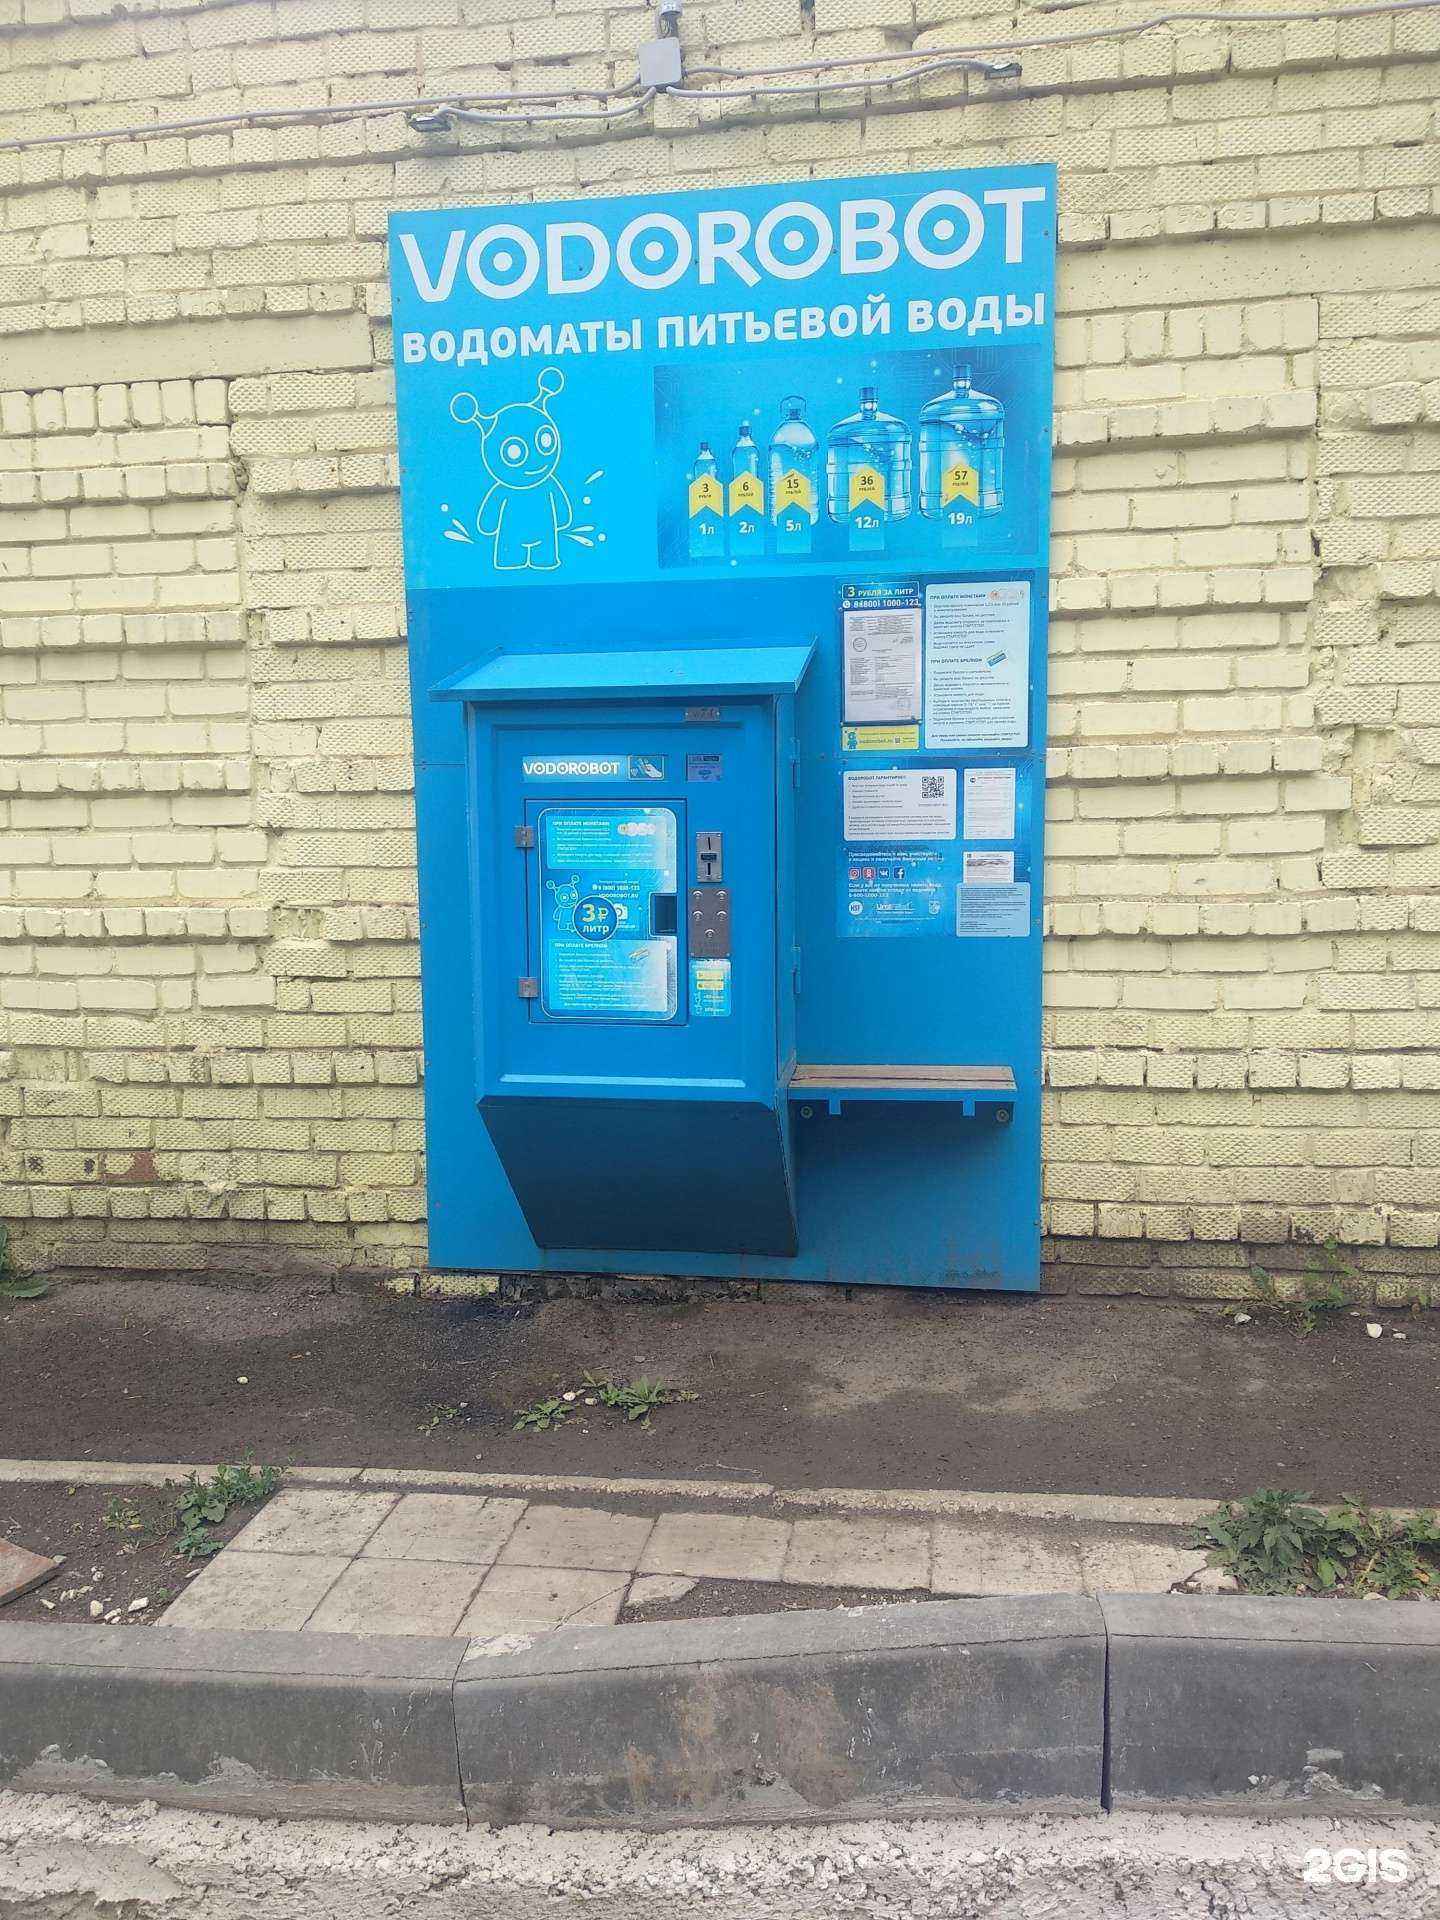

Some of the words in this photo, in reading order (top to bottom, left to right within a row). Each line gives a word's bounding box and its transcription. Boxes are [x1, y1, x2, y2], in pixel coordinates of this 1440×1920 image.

[399, 187, 1046, 302] VODOROBOT
[402, 318, 643, 367] ВОДОМАТЫ
[657, 293, 891, 349] ПИТЬЕВОЙ
[907, 293, 1045, 336] ВОДЫ
[860, 475, 874, 486] 36
[954, 470, 968, 481] 57
[702, 483, 709, 493] 3
[742, 481, 749, 492] 6
[786, 478, 799, 489] 15
[854, 516, 879, 529] 12л
[948, 512, 973, 525] 19л
[700, 524, 715, 535] 1л
[739, 521, 755, 534] 2л
[785, 520, 802, 532] 5л
[847, 586, 856, 597] 3
[894, 588, 914, 596] ЛИТР
[523, 762, 621, 776] VODOROBOT
[582, 904, 596, 922] 3
[583, 924, 609, 935] литр
